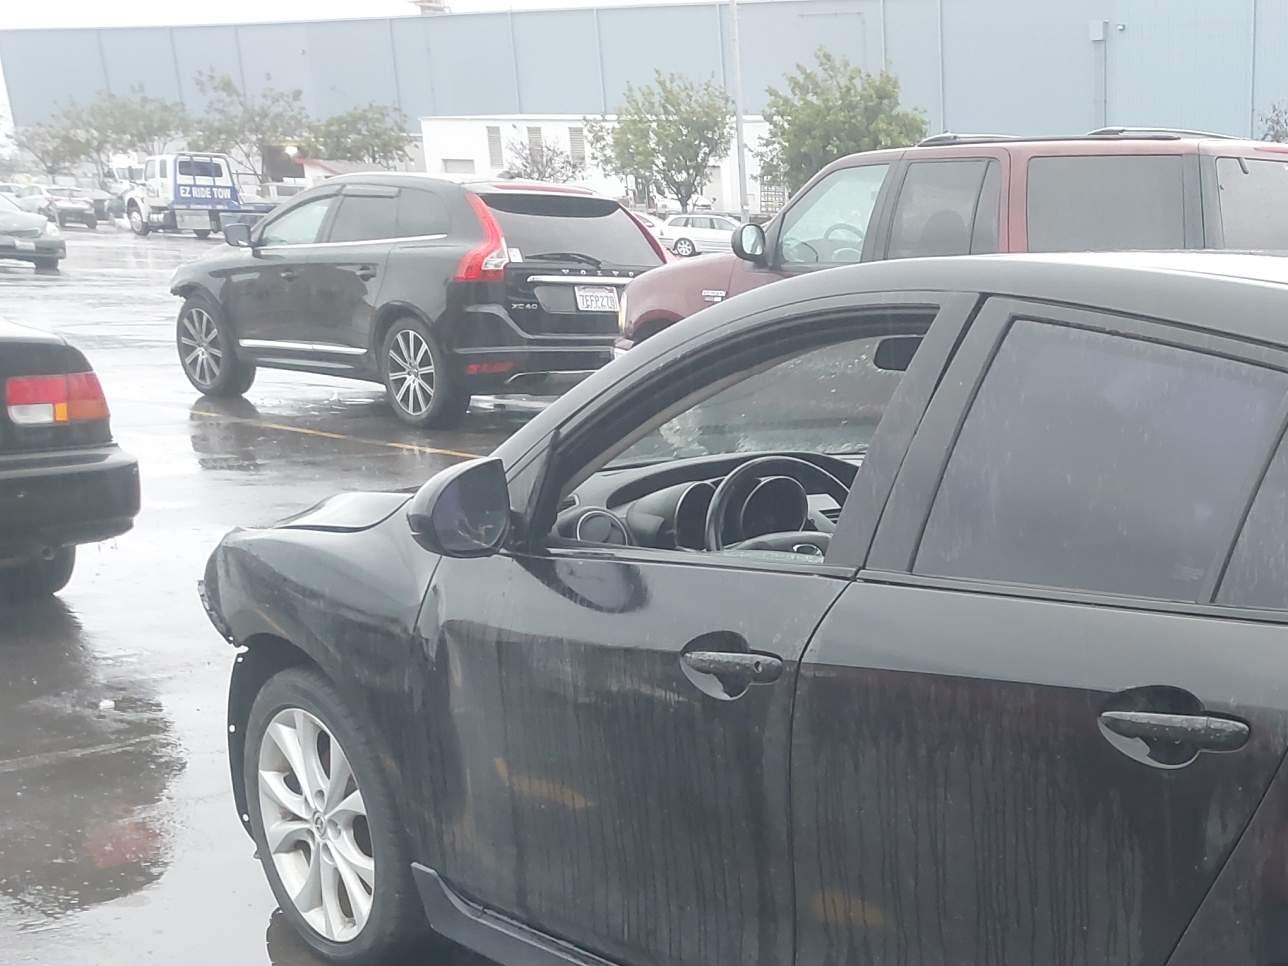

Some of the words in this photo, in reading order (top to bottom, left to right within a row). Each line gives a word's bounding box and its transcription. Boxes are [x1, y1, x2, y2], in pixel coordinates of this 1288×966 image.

[180, 186, 191, 197] EZ
[212, 188, 231, 199] TOW
[561, 269, 634, 277] VOLVO
